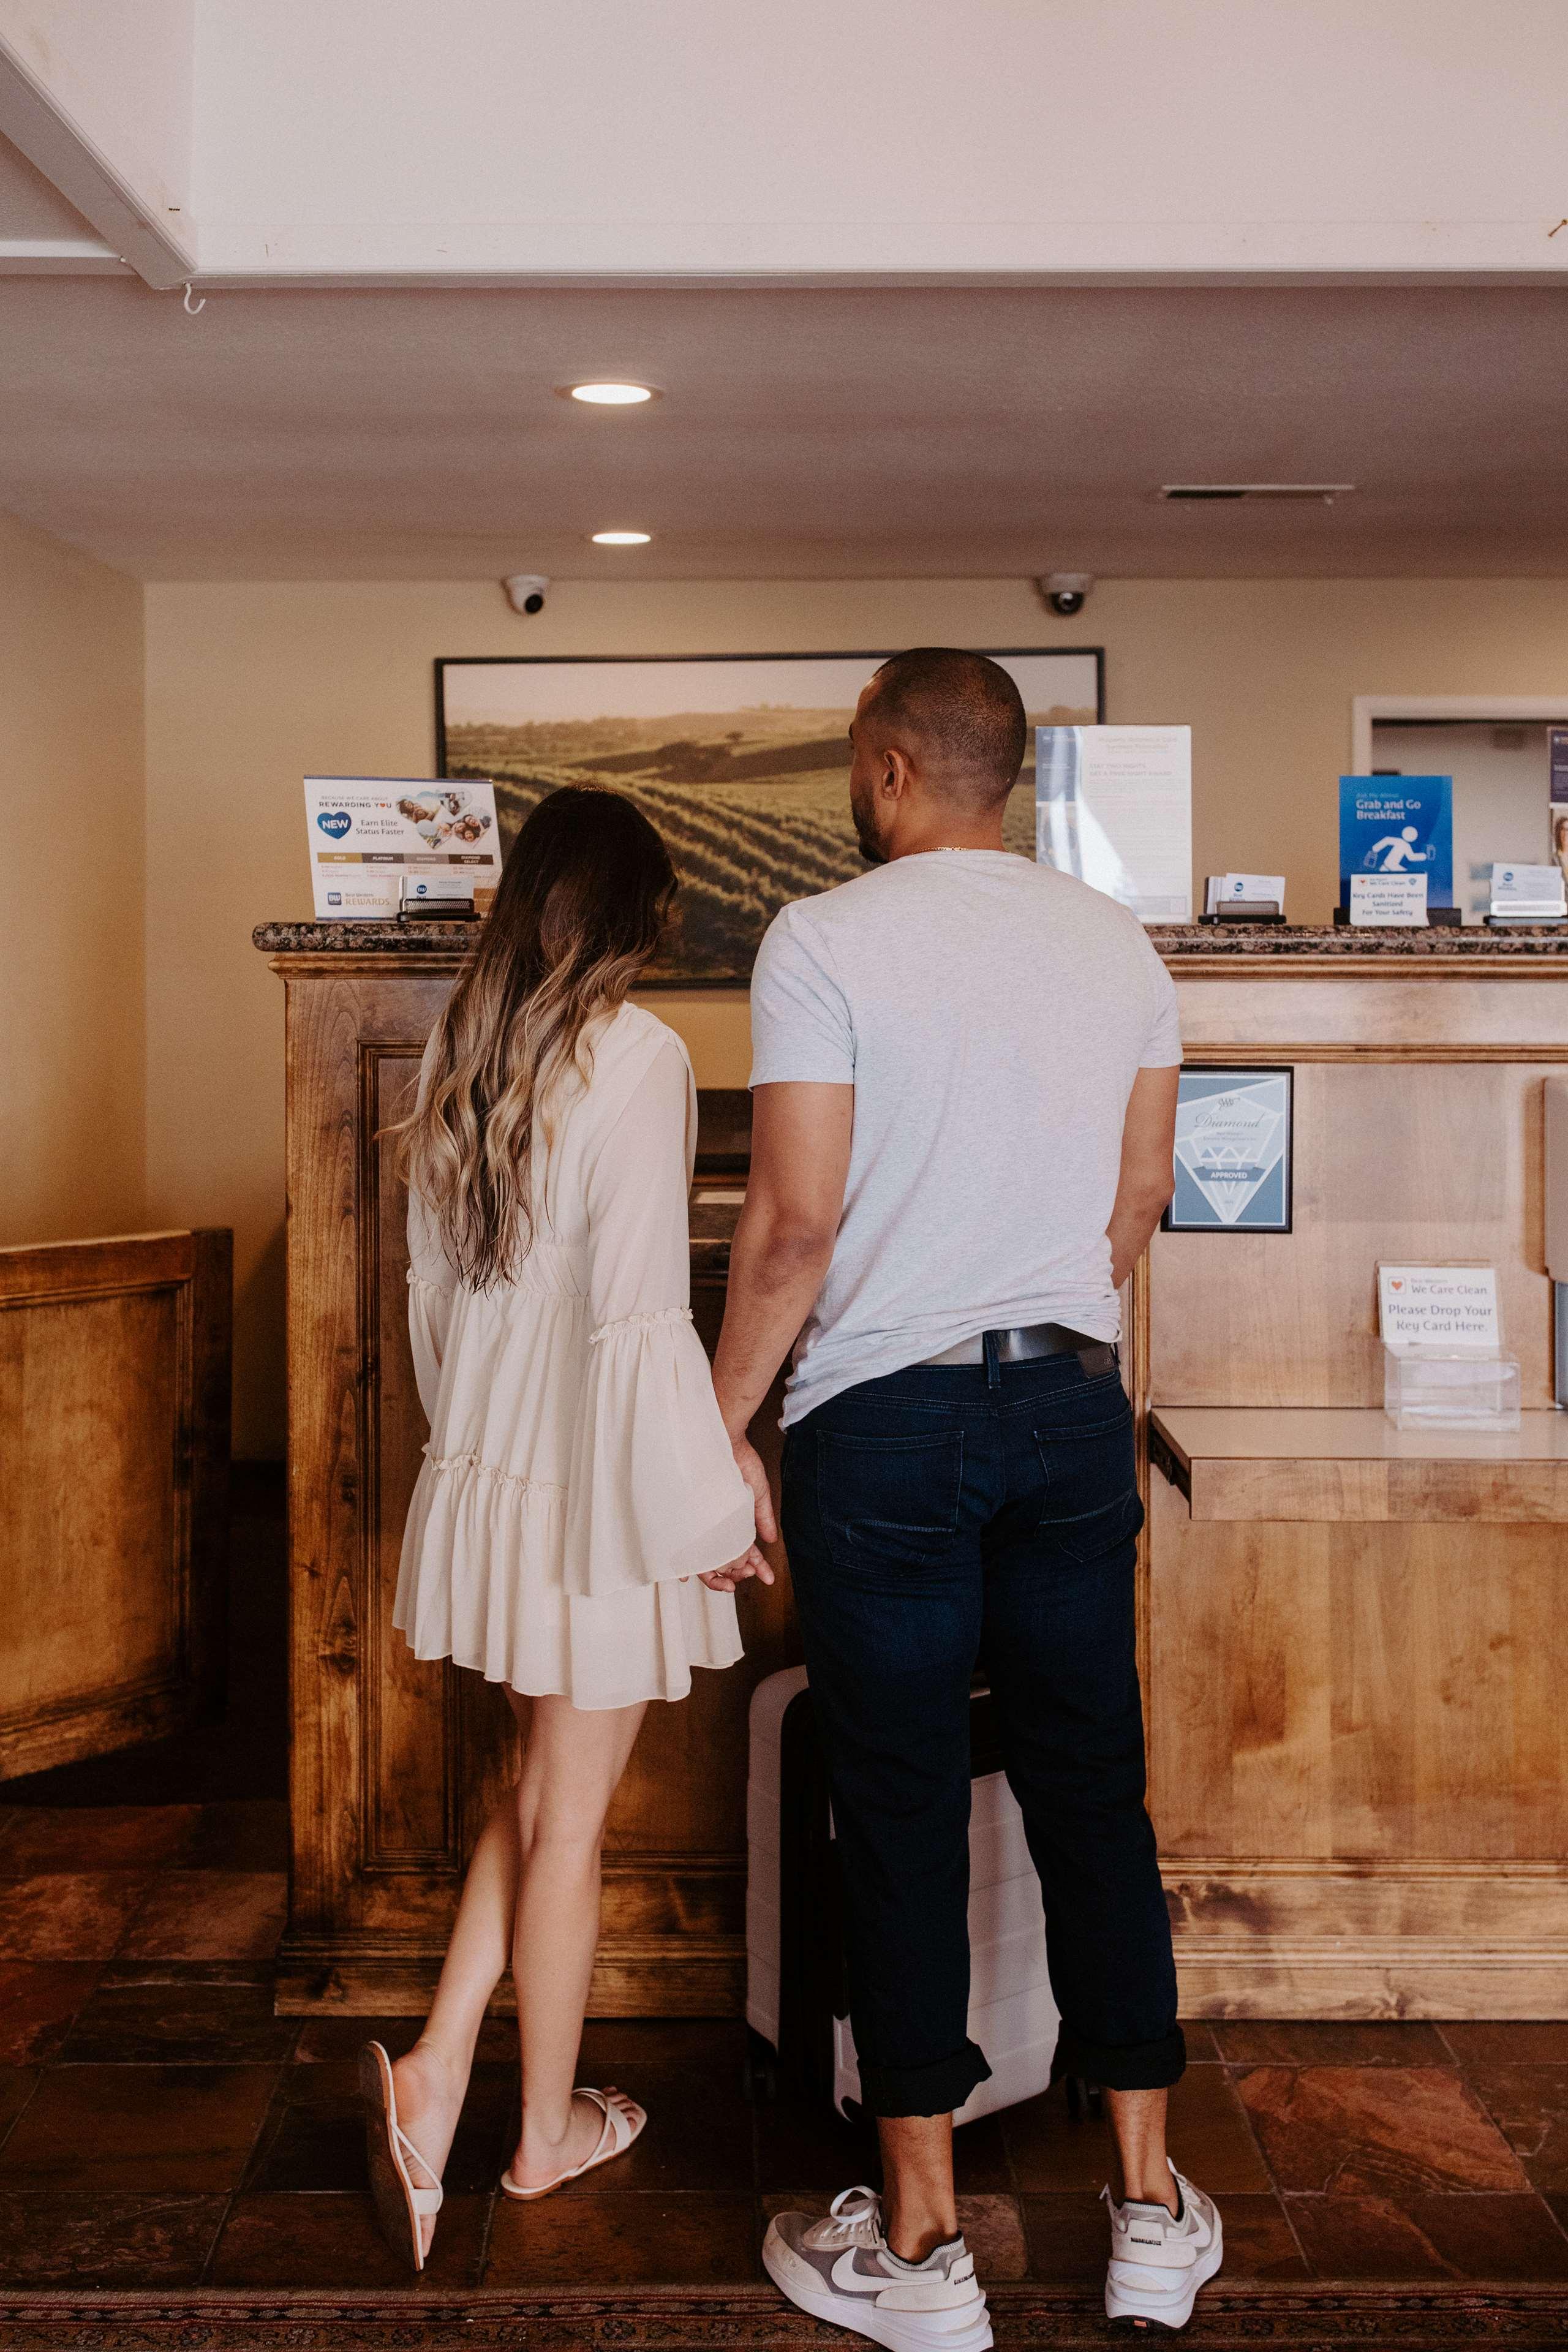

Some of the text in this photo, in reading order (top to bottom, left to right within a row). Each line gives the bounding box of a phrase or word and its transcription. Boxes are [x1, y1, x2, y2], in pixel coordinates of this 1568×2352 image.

[1356, 799, 1421, 809] Grab and Go
[1356, 809, 1406, 820] Breakfast
[322, 819, 349, 829] NEW
[1194, 1112, 1265, 1128] Diamond
[1412, 1284, 1488, 1294] We Care Clean
[1389, 1304, 1493, 1317] Please Drop Your
[1396, 1320, 1488, 1333] Key Card Here.
